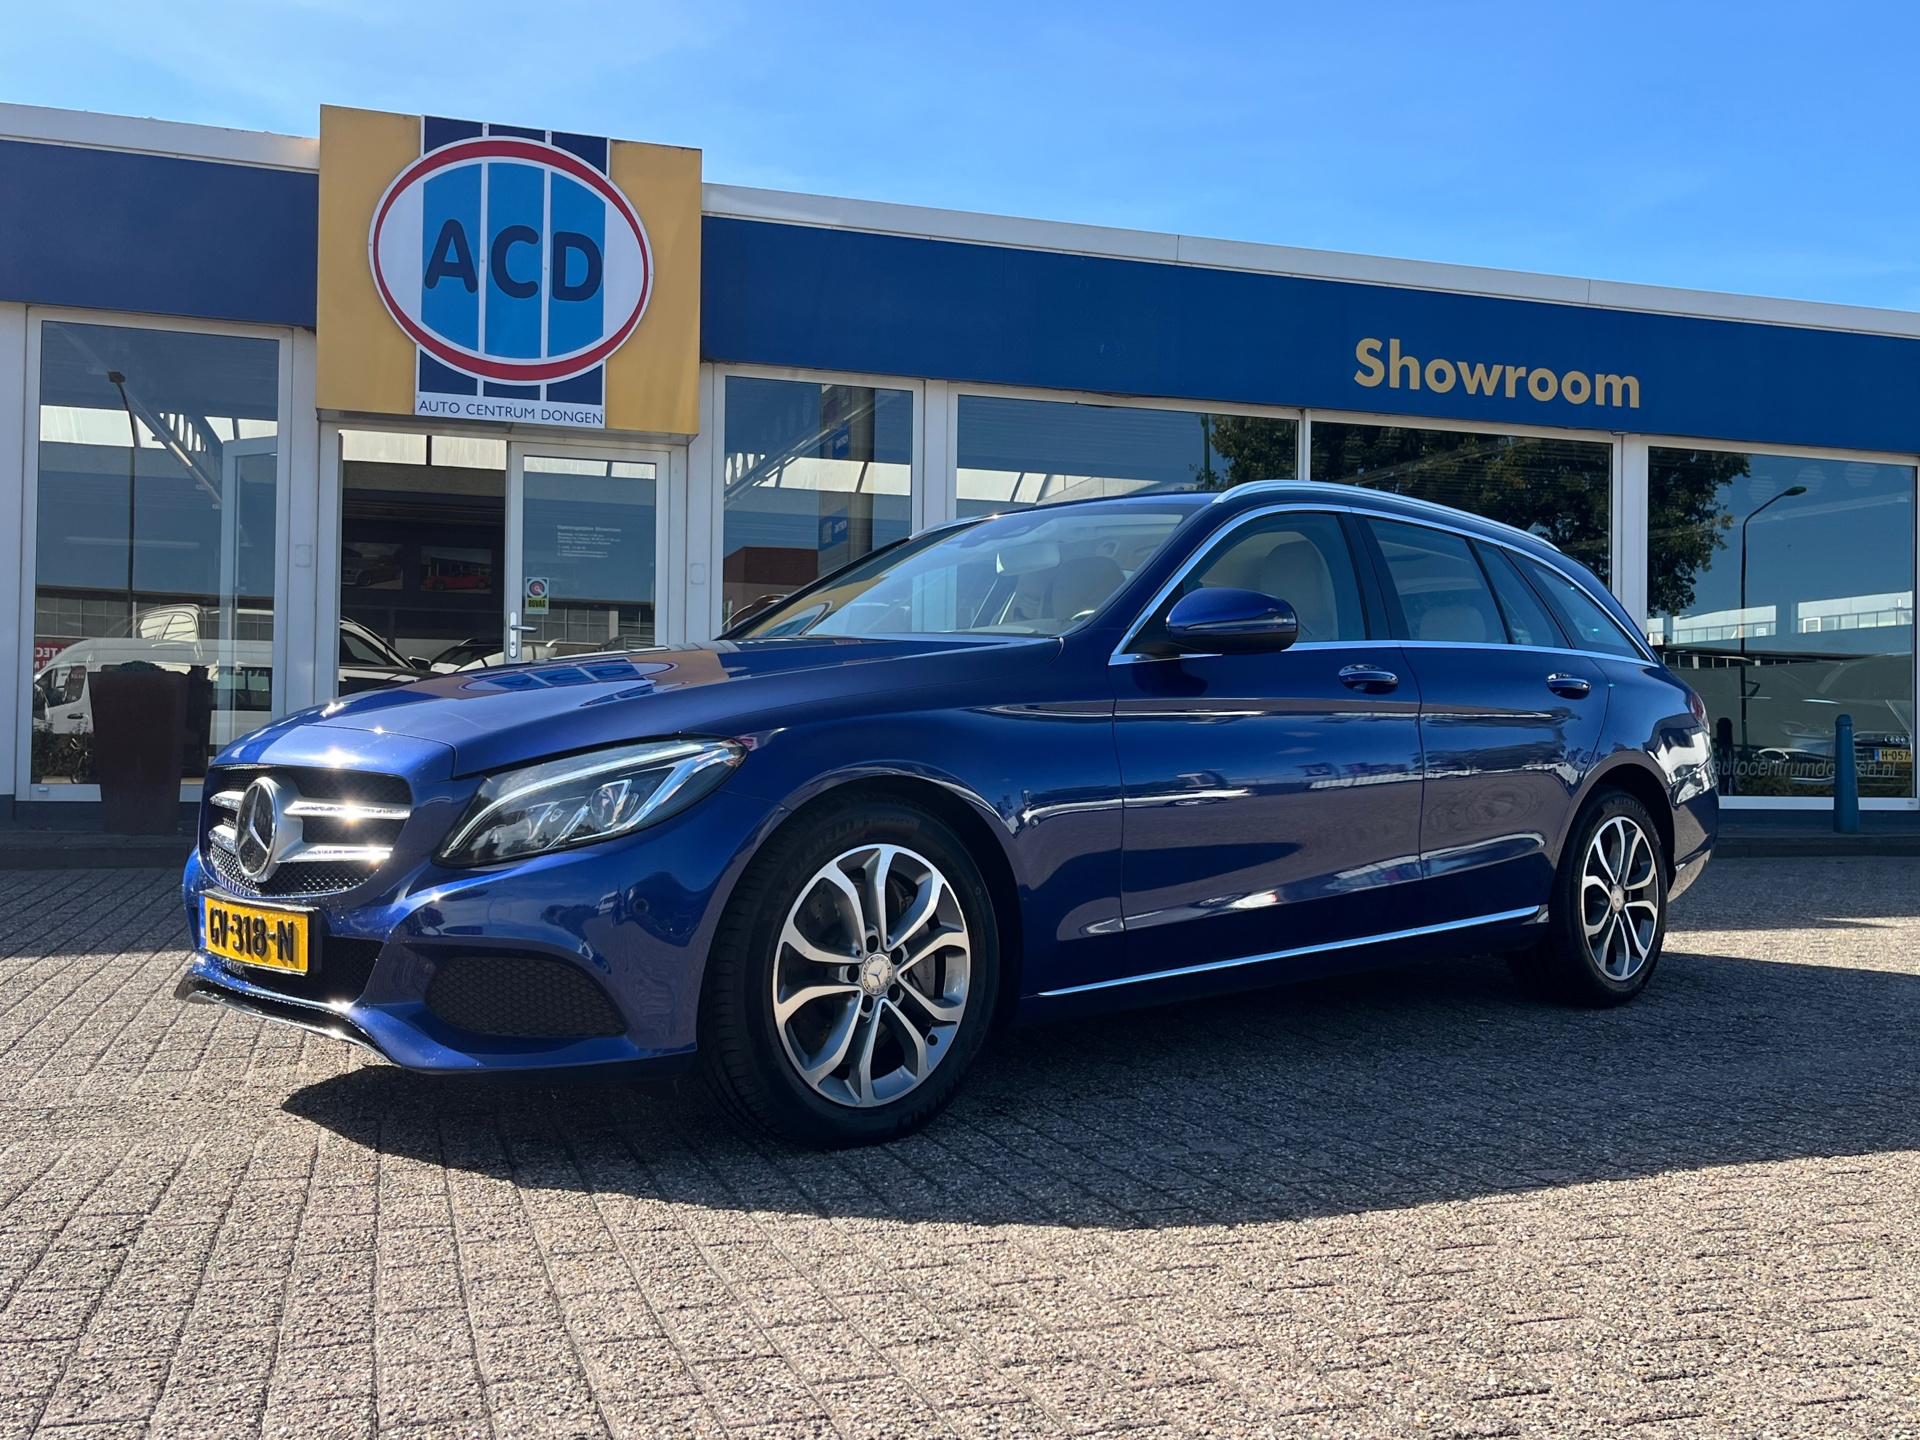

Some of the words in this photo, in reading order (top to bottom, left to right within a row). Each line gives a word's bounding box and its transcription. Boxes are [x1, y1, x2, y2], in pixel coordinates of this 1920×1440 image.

[424, 218, 603, 302] ACD
[1353, 337, 1640, 408] Showroom
[418, 400, 460, 414] AUTO
[465, 403, 535, 420] CENTRUM
[541, 409, 603, 425] DONGEN
[1715, 758, 1896, 776] autocentrumdoen.nl
[209, 907, 295, 962] GV-318-N
